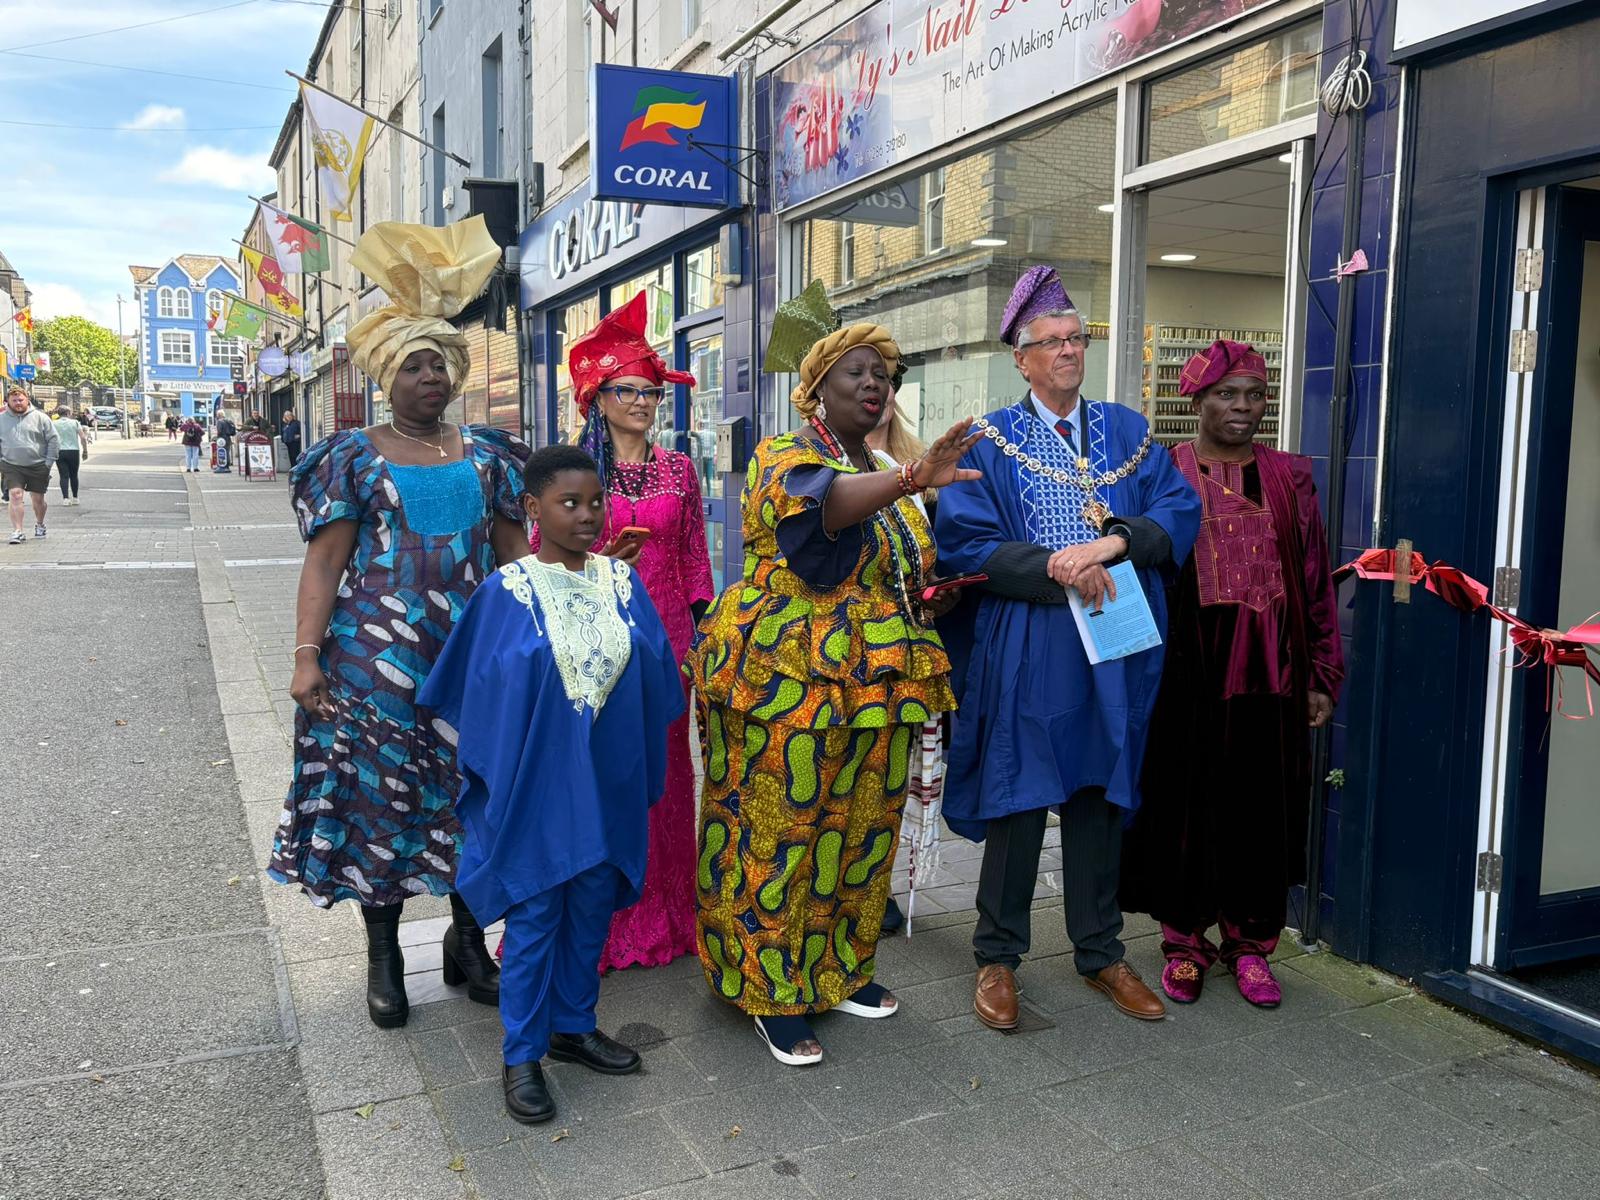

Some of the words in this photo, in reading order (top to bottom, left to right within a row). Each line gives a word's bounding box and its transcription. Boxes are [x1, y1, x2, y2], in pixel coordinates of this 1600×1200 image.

[906, 0, 981, 66] Nail
[942, 70, 961, 94] The
[964, 60, 985, 84] Art
[989, 42, 1006, 71] Of
[1009, 29, 1054, 63] Making
[1058, 0, 1108, 39] Acrylic
[613, 164, 712, 191] CORAL
[550, 198, 640, 280] CORAL
